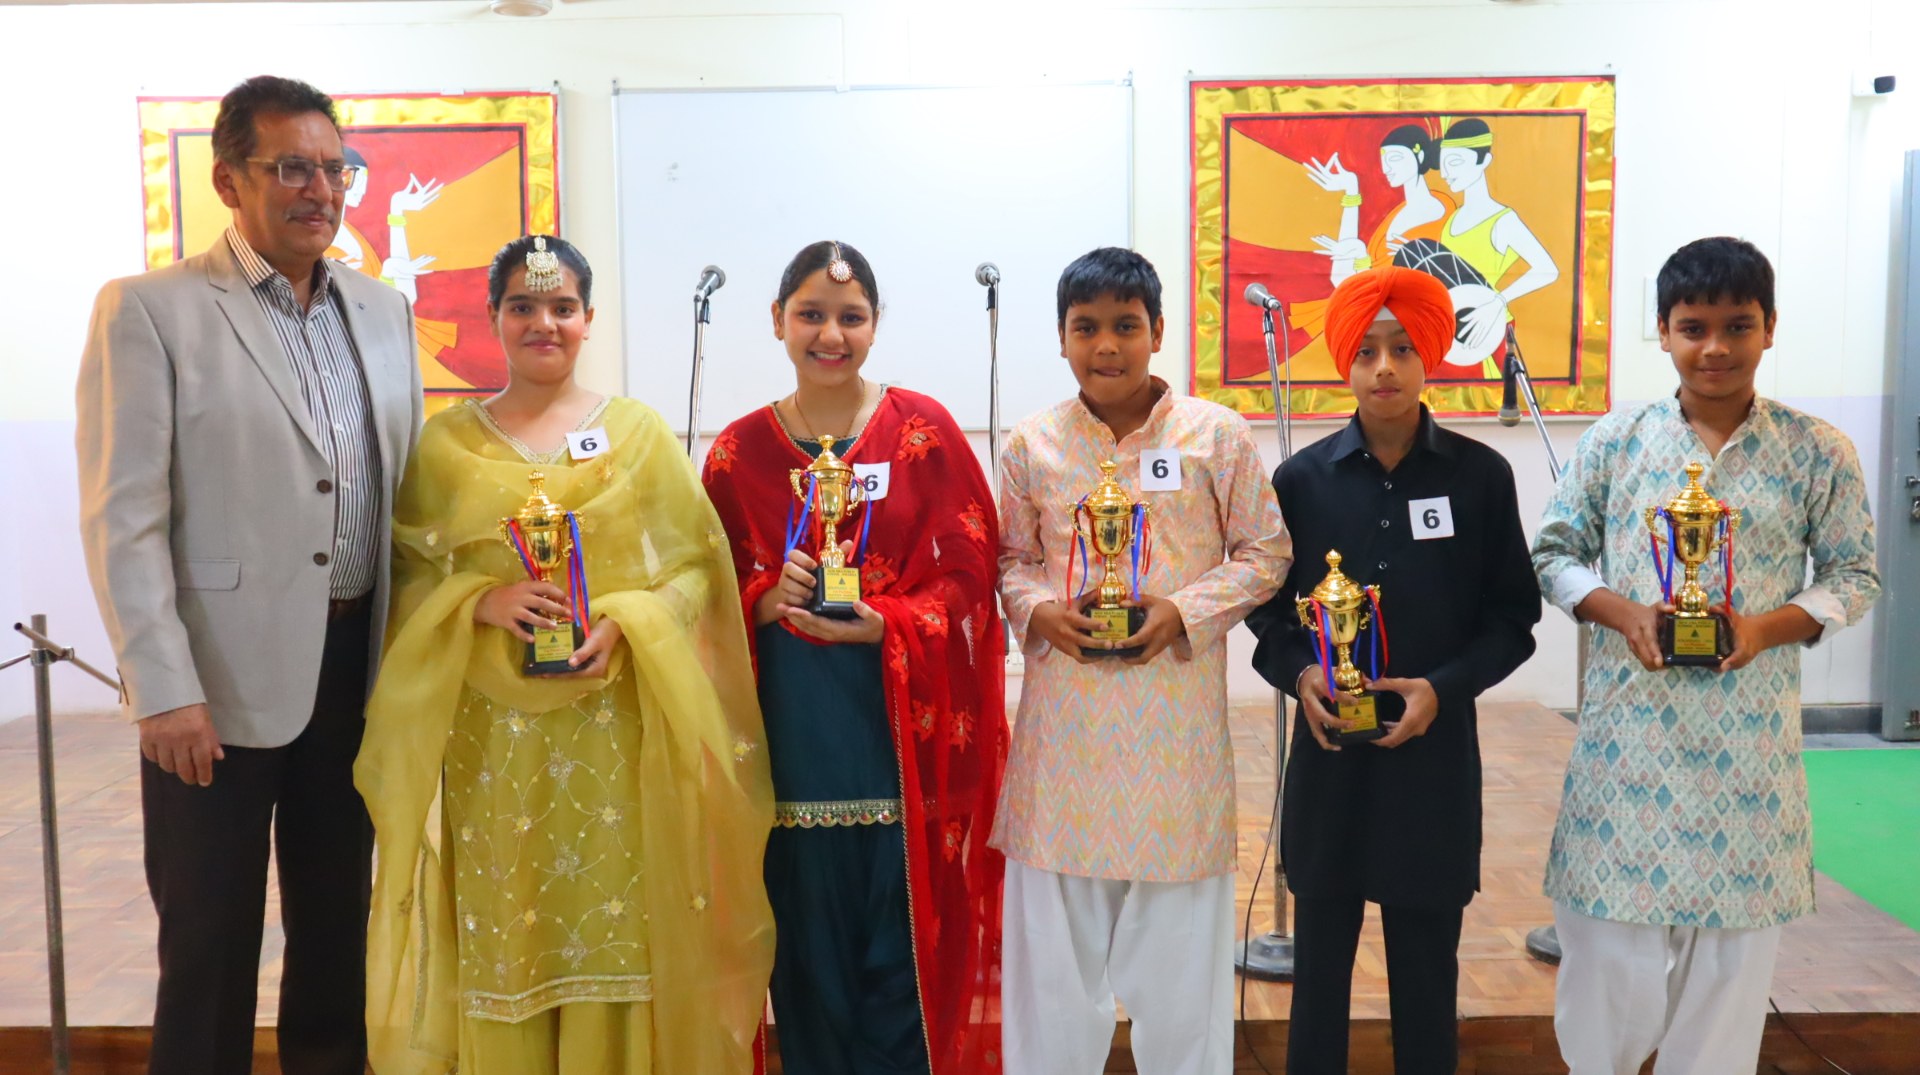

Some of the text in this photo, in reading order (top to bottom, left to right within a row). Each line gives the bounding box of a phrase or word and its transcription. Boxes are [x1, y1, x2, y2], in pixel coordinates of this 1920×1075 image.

[580, 437, 597, 451] 6
[1152, 458, 1169, 479] 6
[864, 474, 878, 492] 6
[1422, 508, 1440, 530] 6
